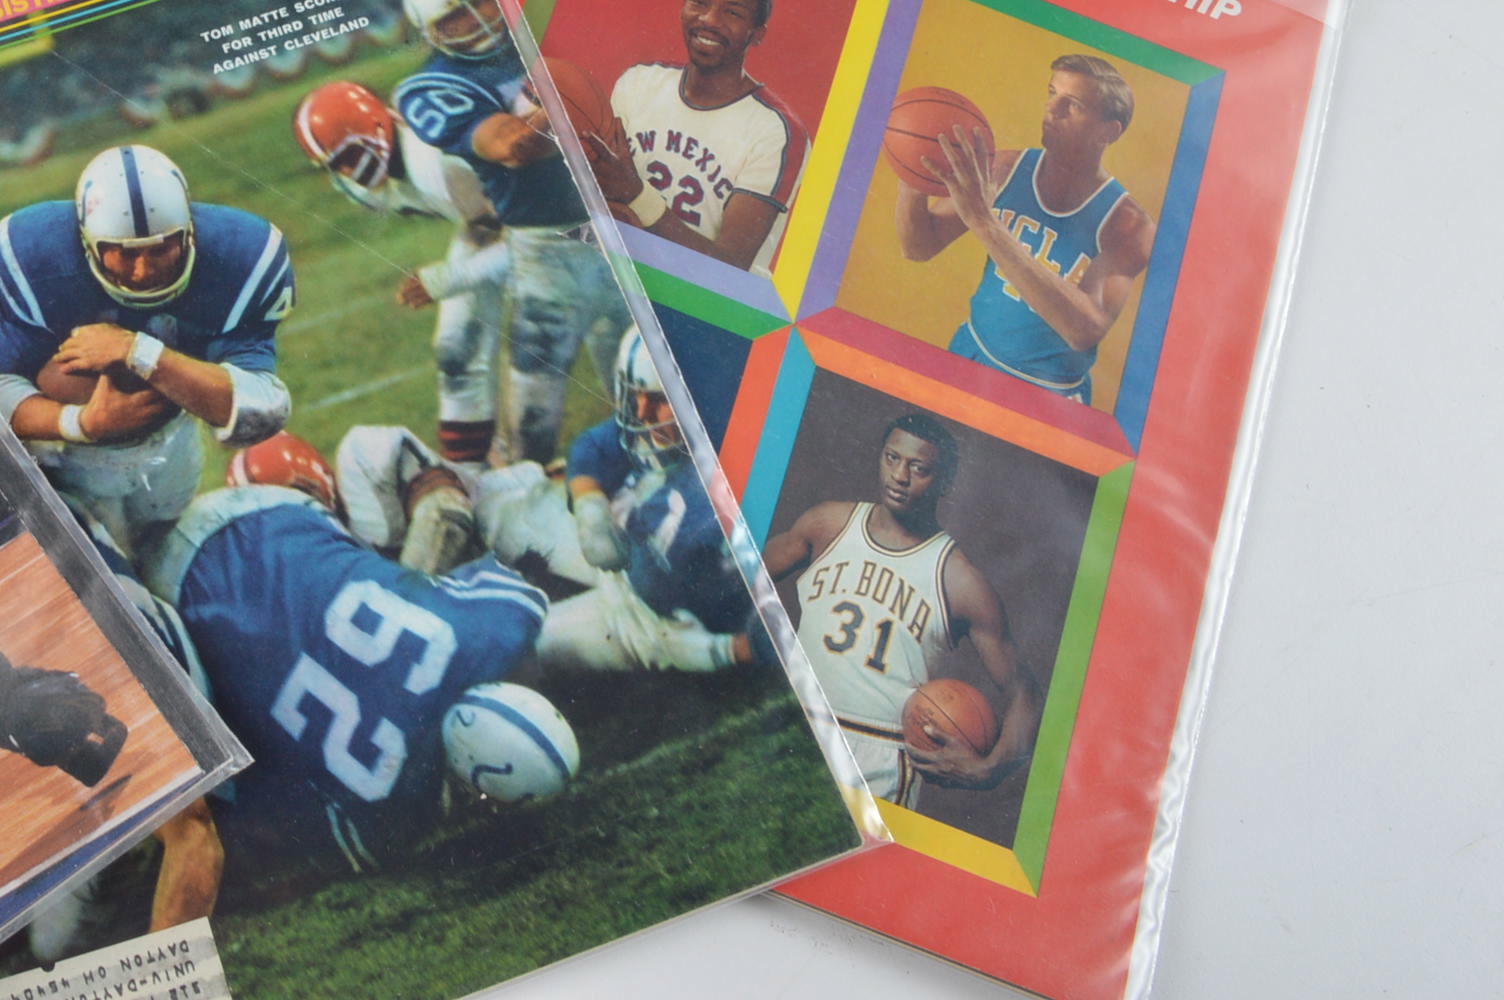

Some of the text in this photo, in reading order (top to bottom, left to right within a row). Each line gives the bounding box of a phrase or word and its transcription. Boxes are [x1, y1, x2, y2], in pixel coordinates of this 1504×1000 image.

[200, 24, 234, 43] TOM
[238, 6, 289, 32] MATTE
[213, 16, 369, 75] AGAINST CLEVELAND
[221, 6, 345, 54] FOR THIRD TIME
[407, 88, 474, 138] 50
[664, 129, 734, 200] MEXIC
[807, 559, 932, 643] ST. BONA
[823, 600, 894, 675] 31
[83, 966, 108, 987] OH
[119, 938, 190, 969] DAYTON
